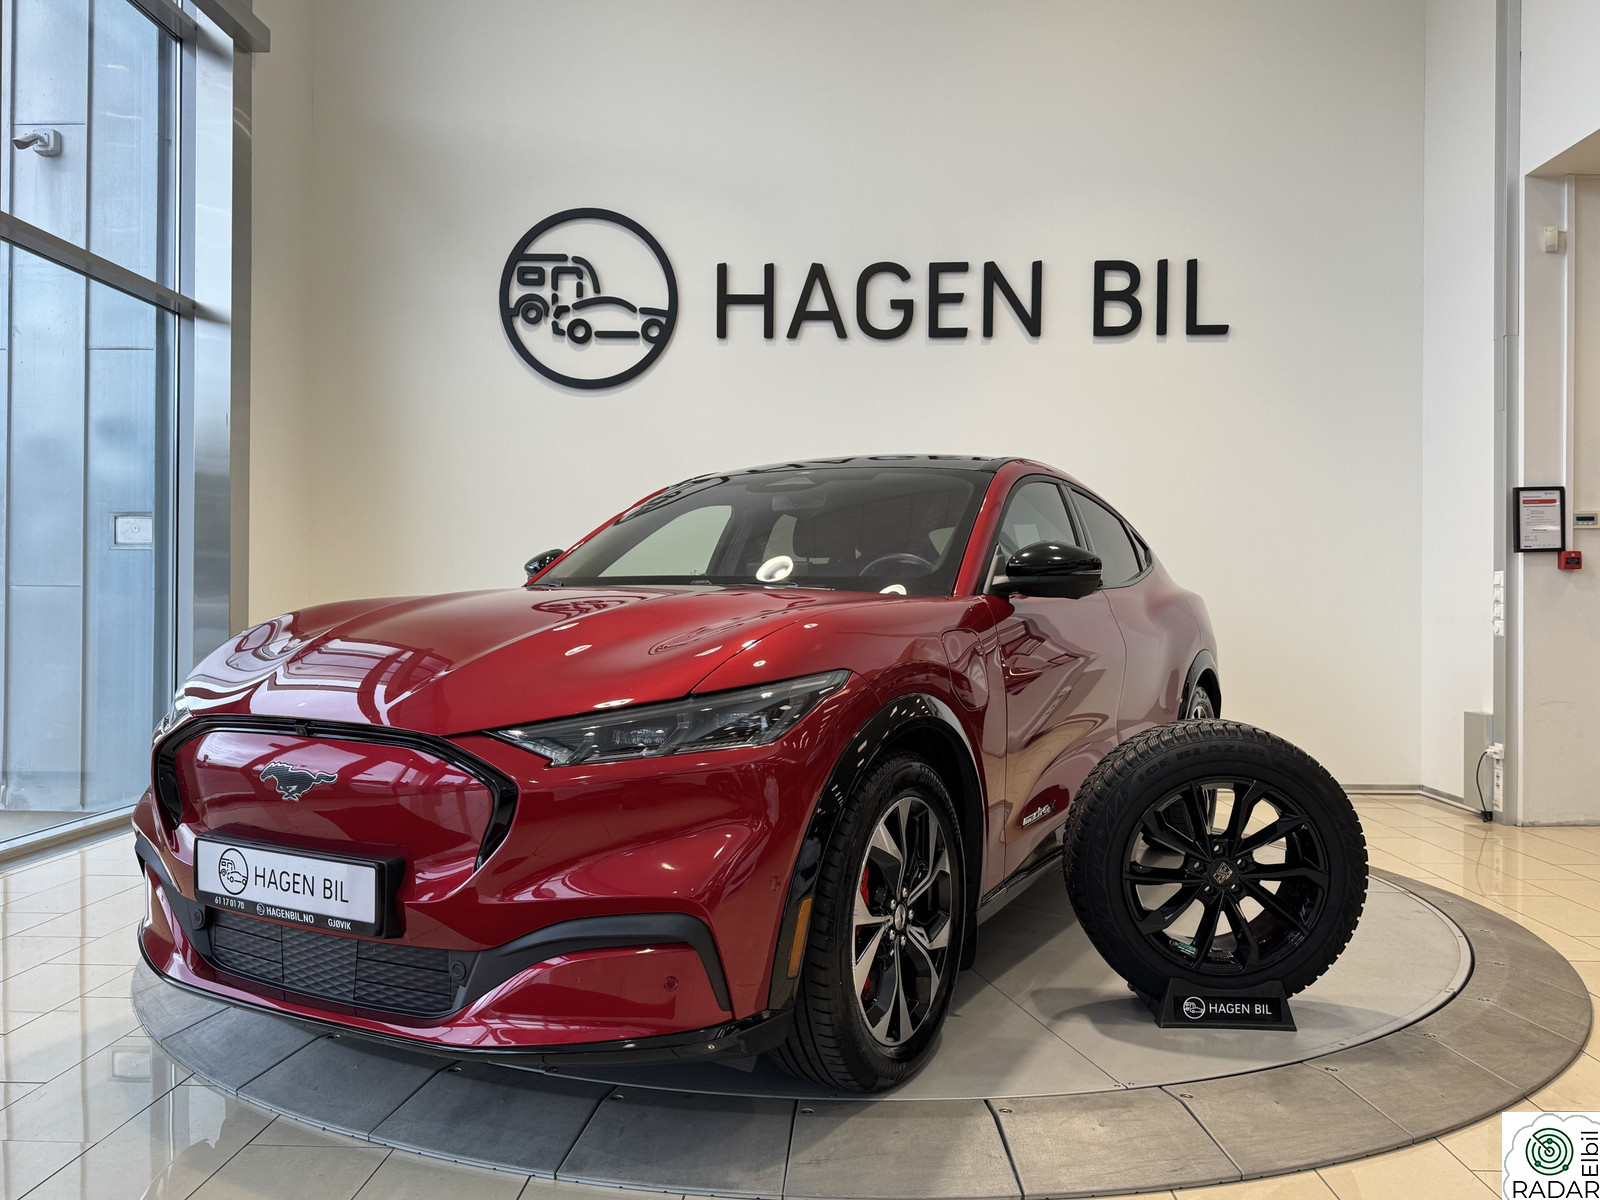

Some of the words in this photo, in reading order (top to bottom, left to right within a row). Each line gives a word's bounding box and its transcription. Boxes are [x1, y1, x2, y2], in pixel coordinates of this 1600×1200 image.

[716, 260, 1043, 340] HAGEN
[1093, 258, 1230, 336] BIL
[254, 866, 315, 897] HAGEN
[323, 878, 349, 903] BIL
[214, 896, 222, 905] 61
[222, 897, 230, 906] 17
[229, 899, 237, 908] 01
[237, 900, 245, 910] 70
[266, 907, 314, 923] HAGENBIL.NO
[328, 918, 351, 930] GJØVIK
[1209, 1003, 1250, 1014] HAGEN
[1254, 1003, 1272, 1015] BIL
